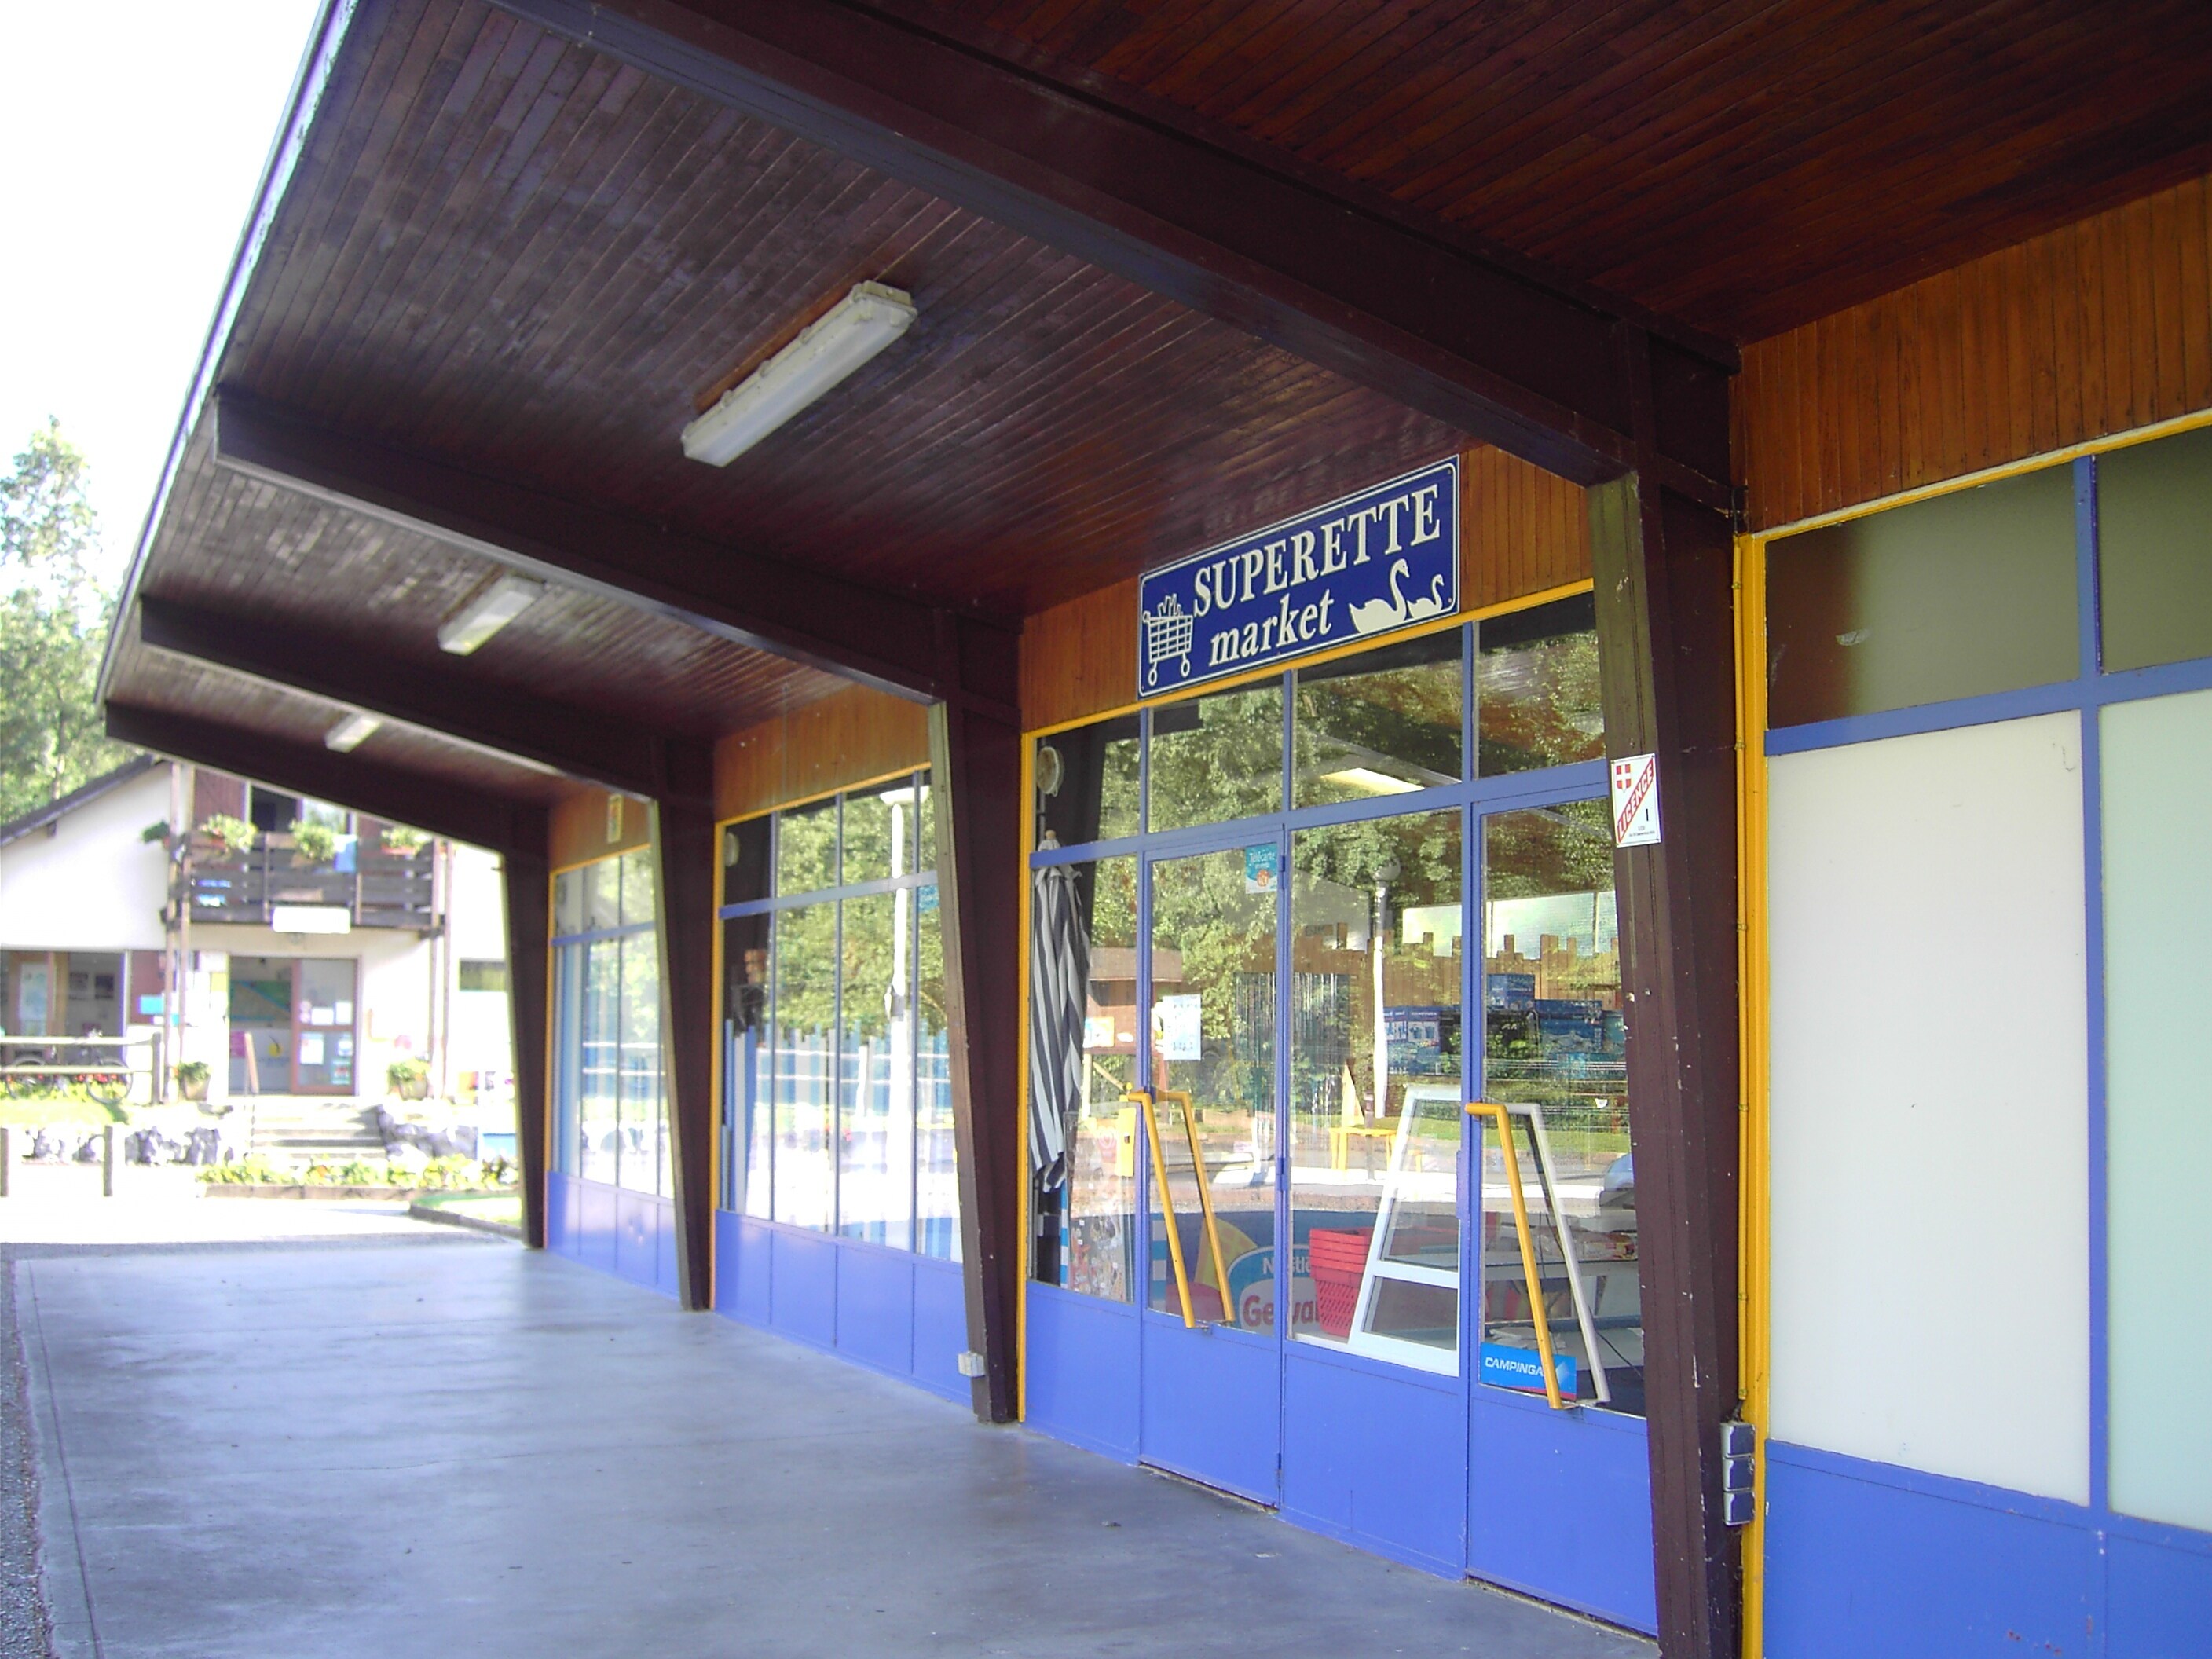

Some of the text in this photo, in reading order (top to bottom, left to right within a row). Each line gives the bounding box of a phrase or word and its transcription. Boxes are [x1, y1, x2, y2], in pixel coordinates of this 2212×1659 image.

[1193, 484, 1441, 618] SUPERETTE
[1209, 588, 1335, 667] market
[1618, 760, 1654, 837] LICENCE
[1485, 1357, 1545, 1378] CAMPINGA
